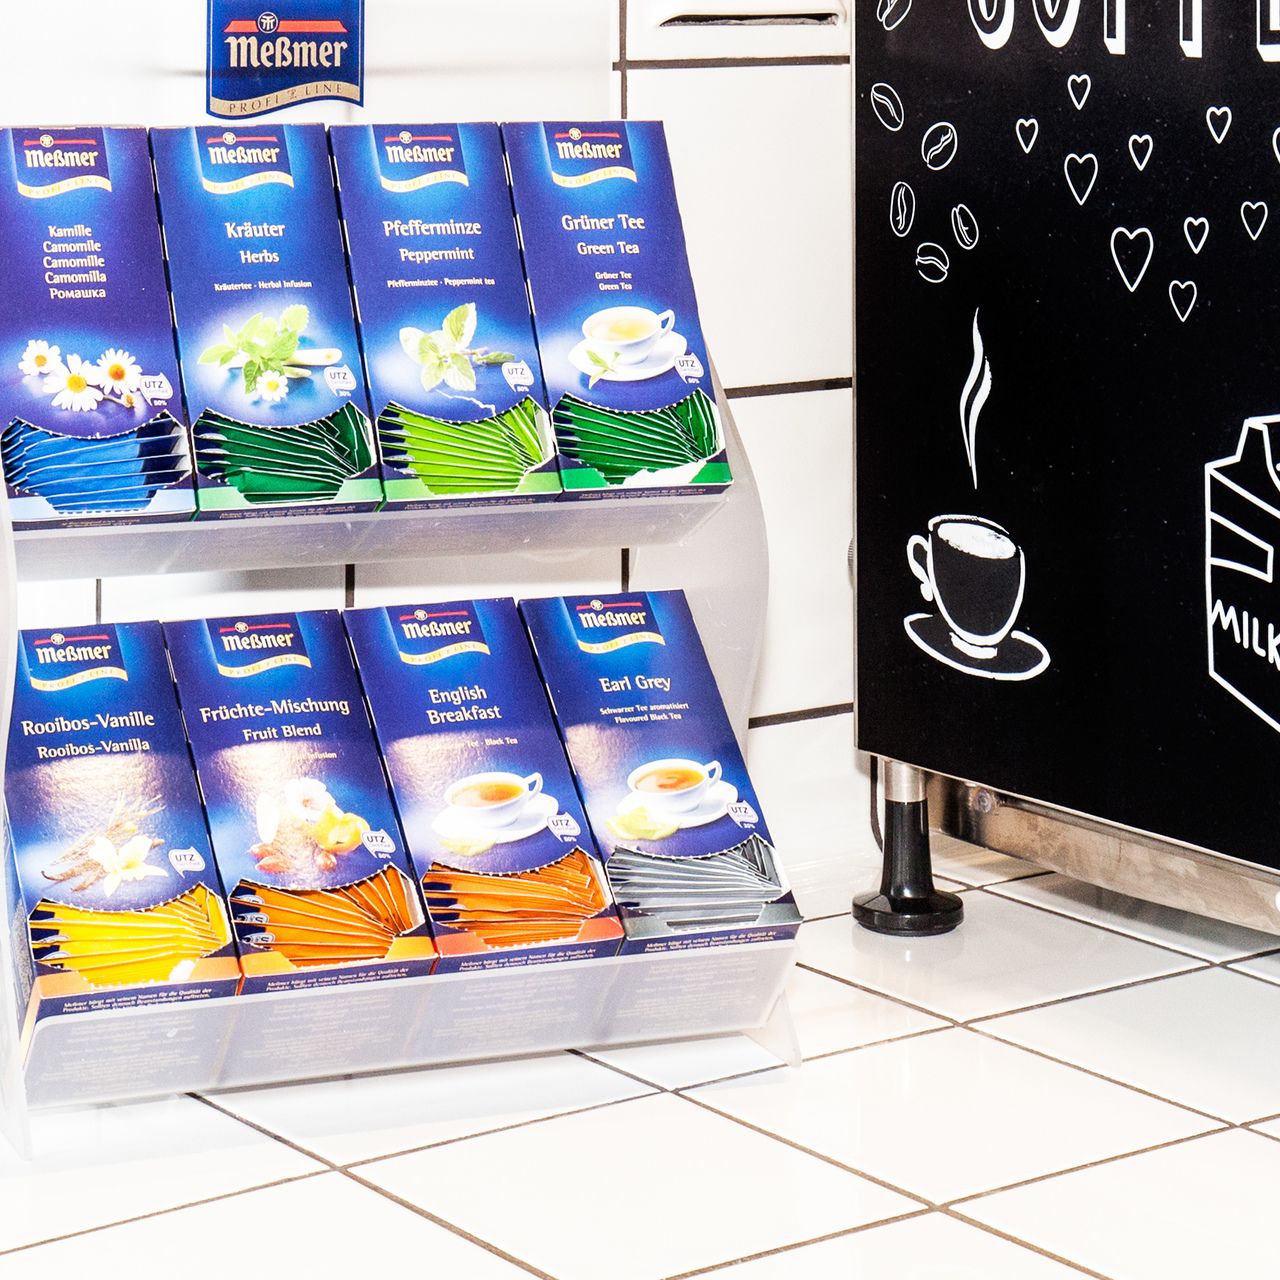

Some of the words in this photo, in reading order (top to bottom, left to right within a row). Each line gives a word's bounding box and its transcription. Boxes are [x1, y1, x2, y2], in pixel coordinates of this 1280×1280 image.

[224, 36, 348, 68] Meßmer
[229, 95, 279, 112] PROFI
[306, 84, 342, 95] LINE
[24, 149, 98, 167] Meßmer
[208, 146, 279, 164] Meßmer
[386, 146, 454, 162] Meßmer
[557, 142, 622, 159] Meßmer
[48, 225, 92, 237] Kamille
[225, 222, 285, 238] Kräuter
[383, 220, 482, 237] Pfefferminze
[561, 215, 615, 231] Grüner
[618, 215, 645, 230] Tee
[43, 240, 101, 252] Camomile
[577, 242, 614, 255] Green
[617, 241, 639, 254] Tea
[43, 255, 105, 268] Camomille
[239, 249, 279, 263] Herbs
[399, 248, 474, 264] Peppermint
[44, 271, 106, 283] Camomilla
[444, 278, 483, 286] Peppermint
[620, 271, 632, 279] Tee
[283, 280, 312, 288] Infusion
[620, 282, 632, 290] Tea
[49, 287, 106, 299] Ромашка
[578, 611, 646, 629] Meßmer
[401, 621, 472, 639] Meßmer
[222, 633, 294, 651] Meßmer
[36, 645, 112, 664] Meßmer
[599, 677, 631, 692] Earl
[635, 676, 671, 691] Grey
[428, 685, 487, 704] English
[199, 698, 350, 722] Früchte-Mischung
[427, 705, 502, 724] Breakfast
[600, 706, 634, 715] Schwarzer
[21, 711, 155, 736] Rooibos-Vanille
[615, 715, 648, 724] Flavoured
[242, 727, 278, 741] Fruit
[283, 724, 321, 738] Blend
[37, 739, 150, 759] Rooibos-Vanilla
